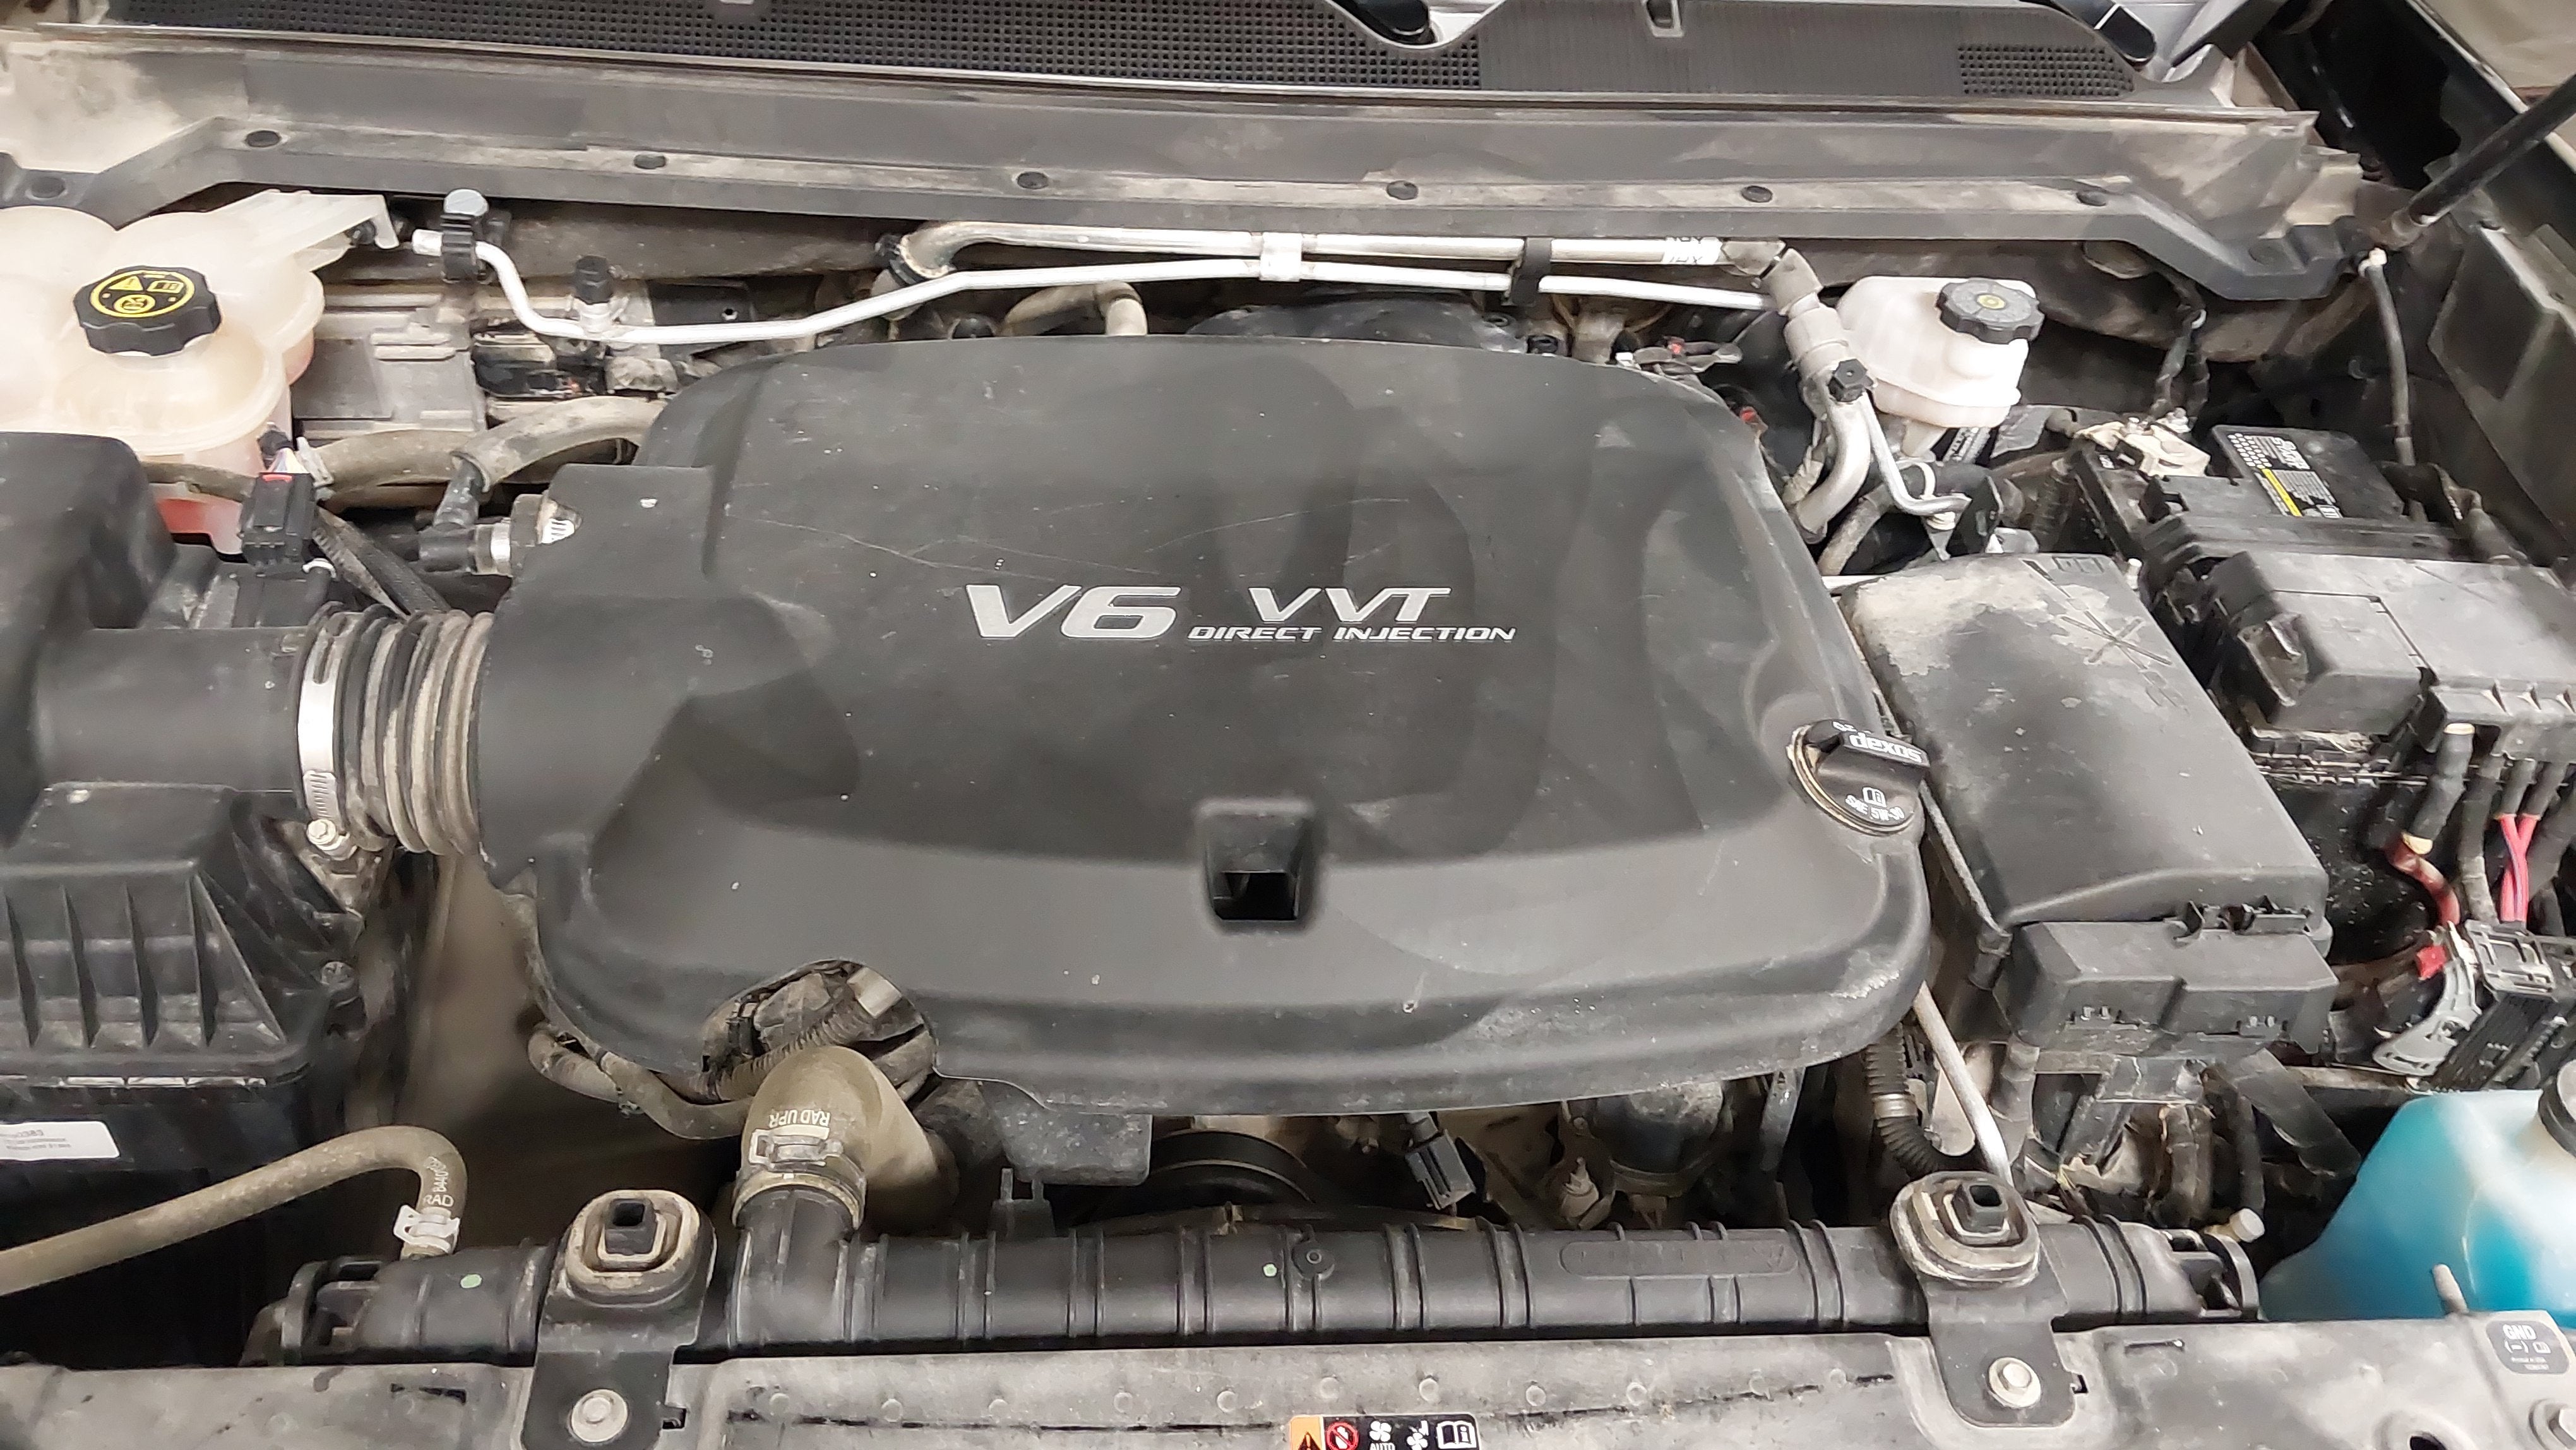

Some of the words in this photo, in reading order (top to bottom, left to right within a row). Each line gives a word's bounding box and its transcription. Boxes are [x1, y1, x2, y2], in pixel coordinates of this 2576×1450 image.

[965, 584, 1181, 638] V6
[1248, 588, 1452, 622] VVT
[1187, 627, 1323, 640] DIRECT
[1333, 627, 1515, 641] INJECTION
[1849, 731, 1923, 763] dexos
[1845, 794, 1868, 815] SAE
[1869, 806, 1905, 821] 5W-30
[769, 1110, 798, 1129] UPR
[800, 1110, 830, 1127] RAD
[422, 1194, 454, 1207] RAD
[2502, 1324, 2537, 1340] GND
